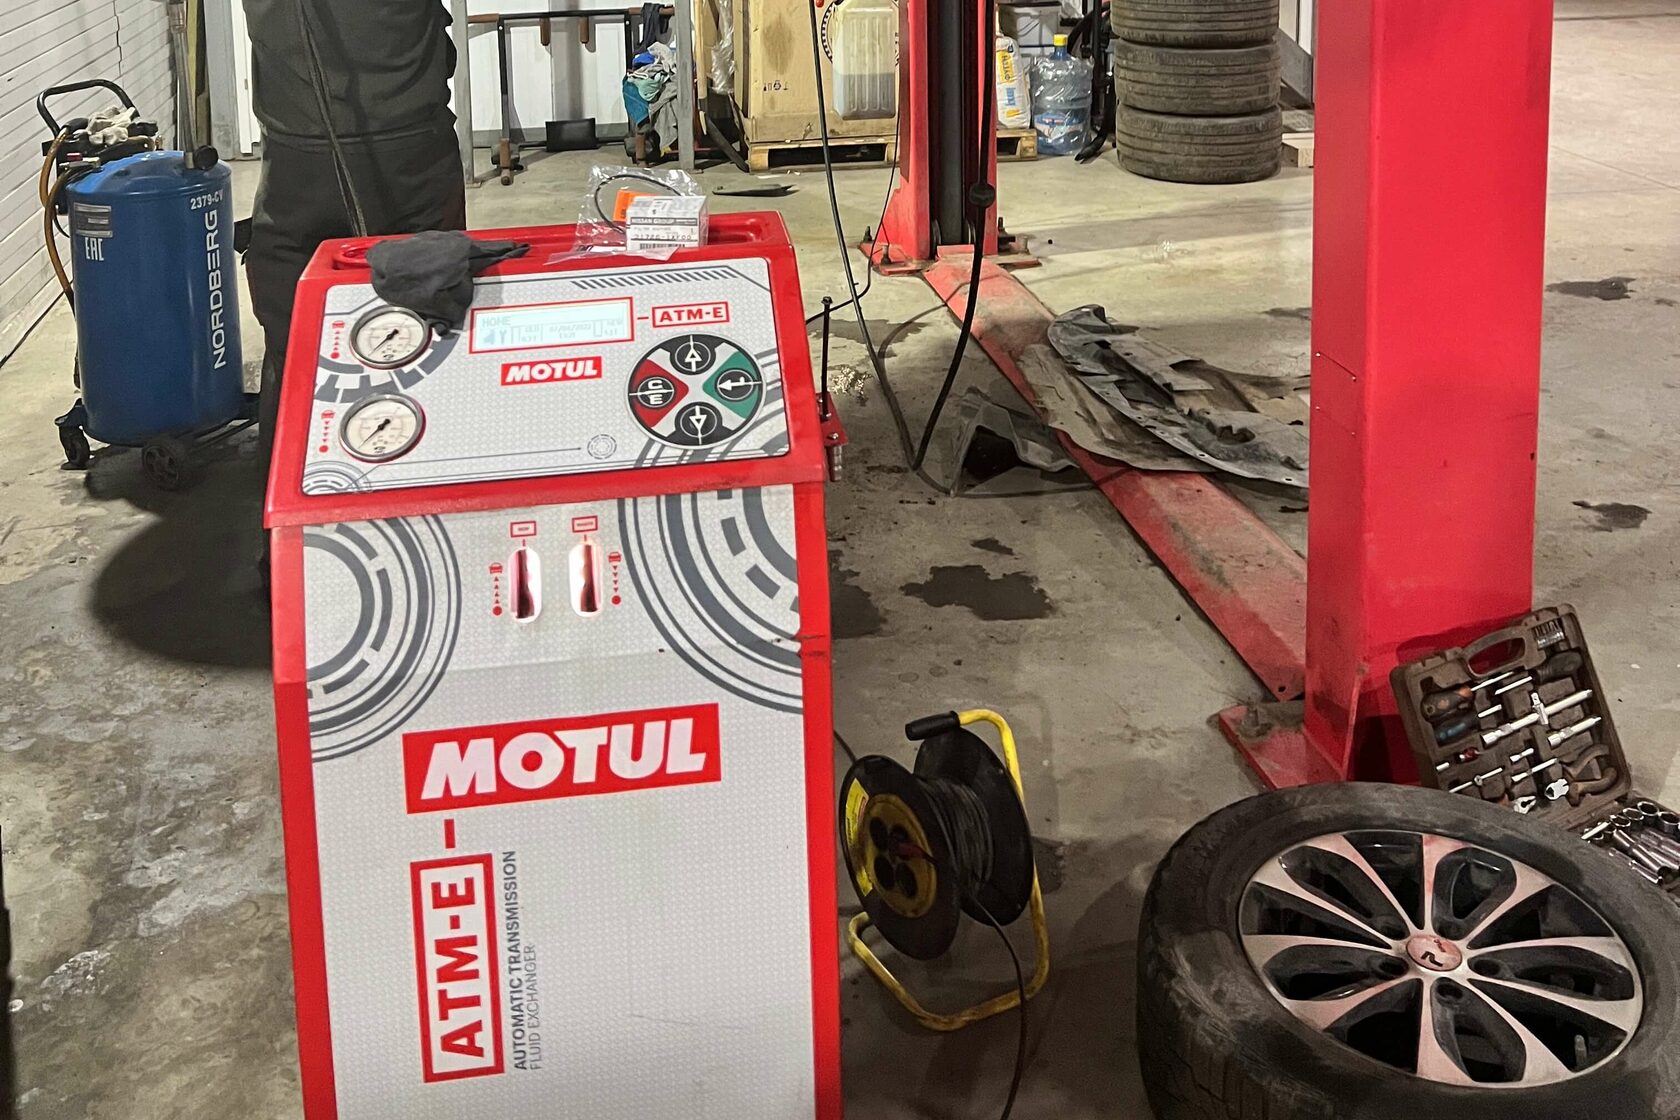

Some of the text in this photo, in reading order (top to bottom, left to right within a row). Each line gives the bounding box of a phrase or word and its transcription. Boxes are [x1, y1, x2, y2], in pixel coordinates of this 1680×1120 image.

[85, 237, 104, 261] EAC
[205, 209, 226, 369] NORDBERG
[659, 306, 723, 322] ATM-E
[505, 360, 597, 383] MOTUL
[421, 718, 706, 800] MOTUL
[431, 877, 484, 1057] ATM-E
[502, 851, 527, 1070] AUTOMATIC TRANSMISSION
[524, 945, 542, 1070] FLUID EXCHANGER
